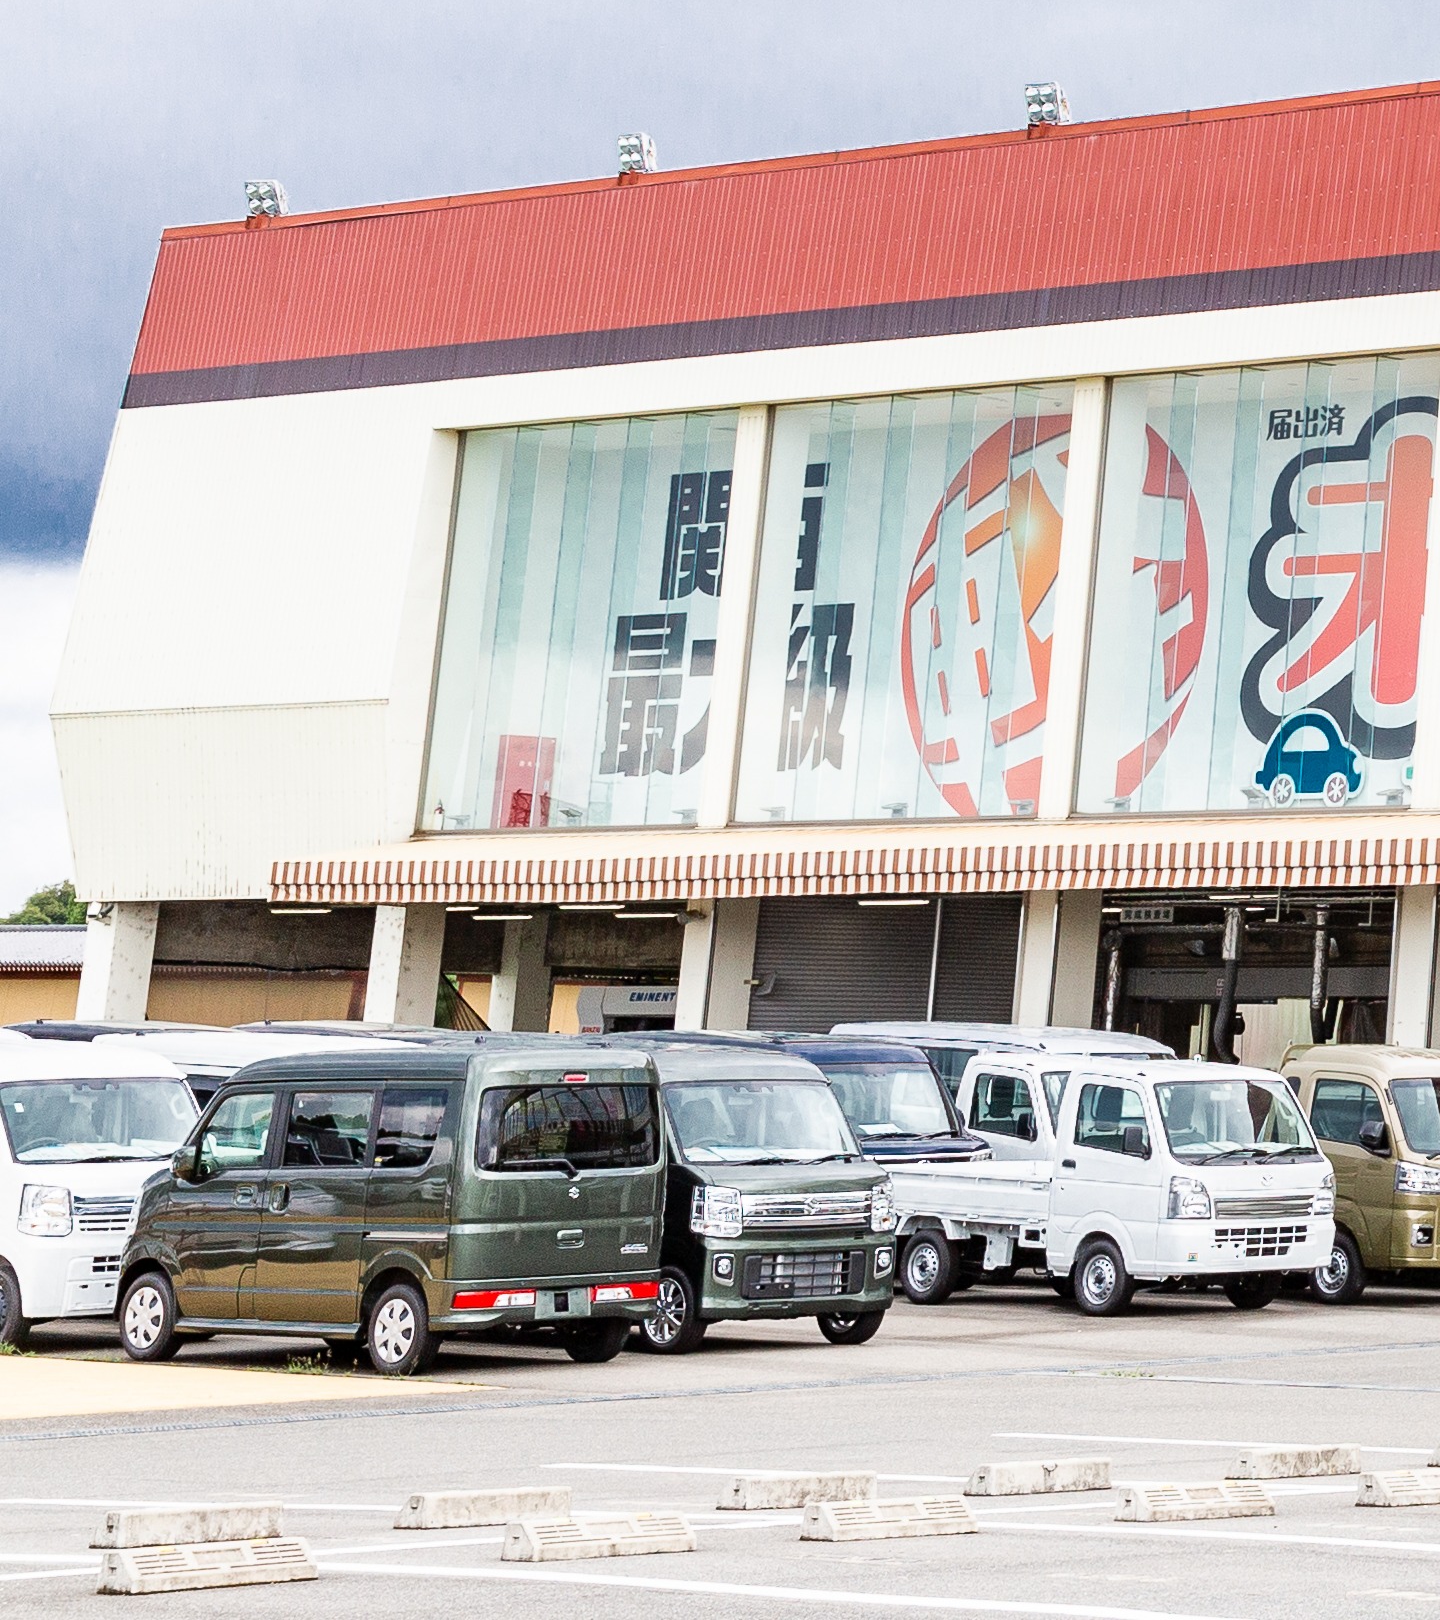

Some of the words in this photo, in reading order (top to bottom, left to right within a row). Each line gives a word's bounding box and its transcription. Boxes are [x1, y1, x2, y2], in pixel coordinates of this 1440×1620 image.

[1266, 404, 1346, 441] 届出済
[659, 463, 830, 601] 関
[629, 992, 676, 1002] EMINENT
